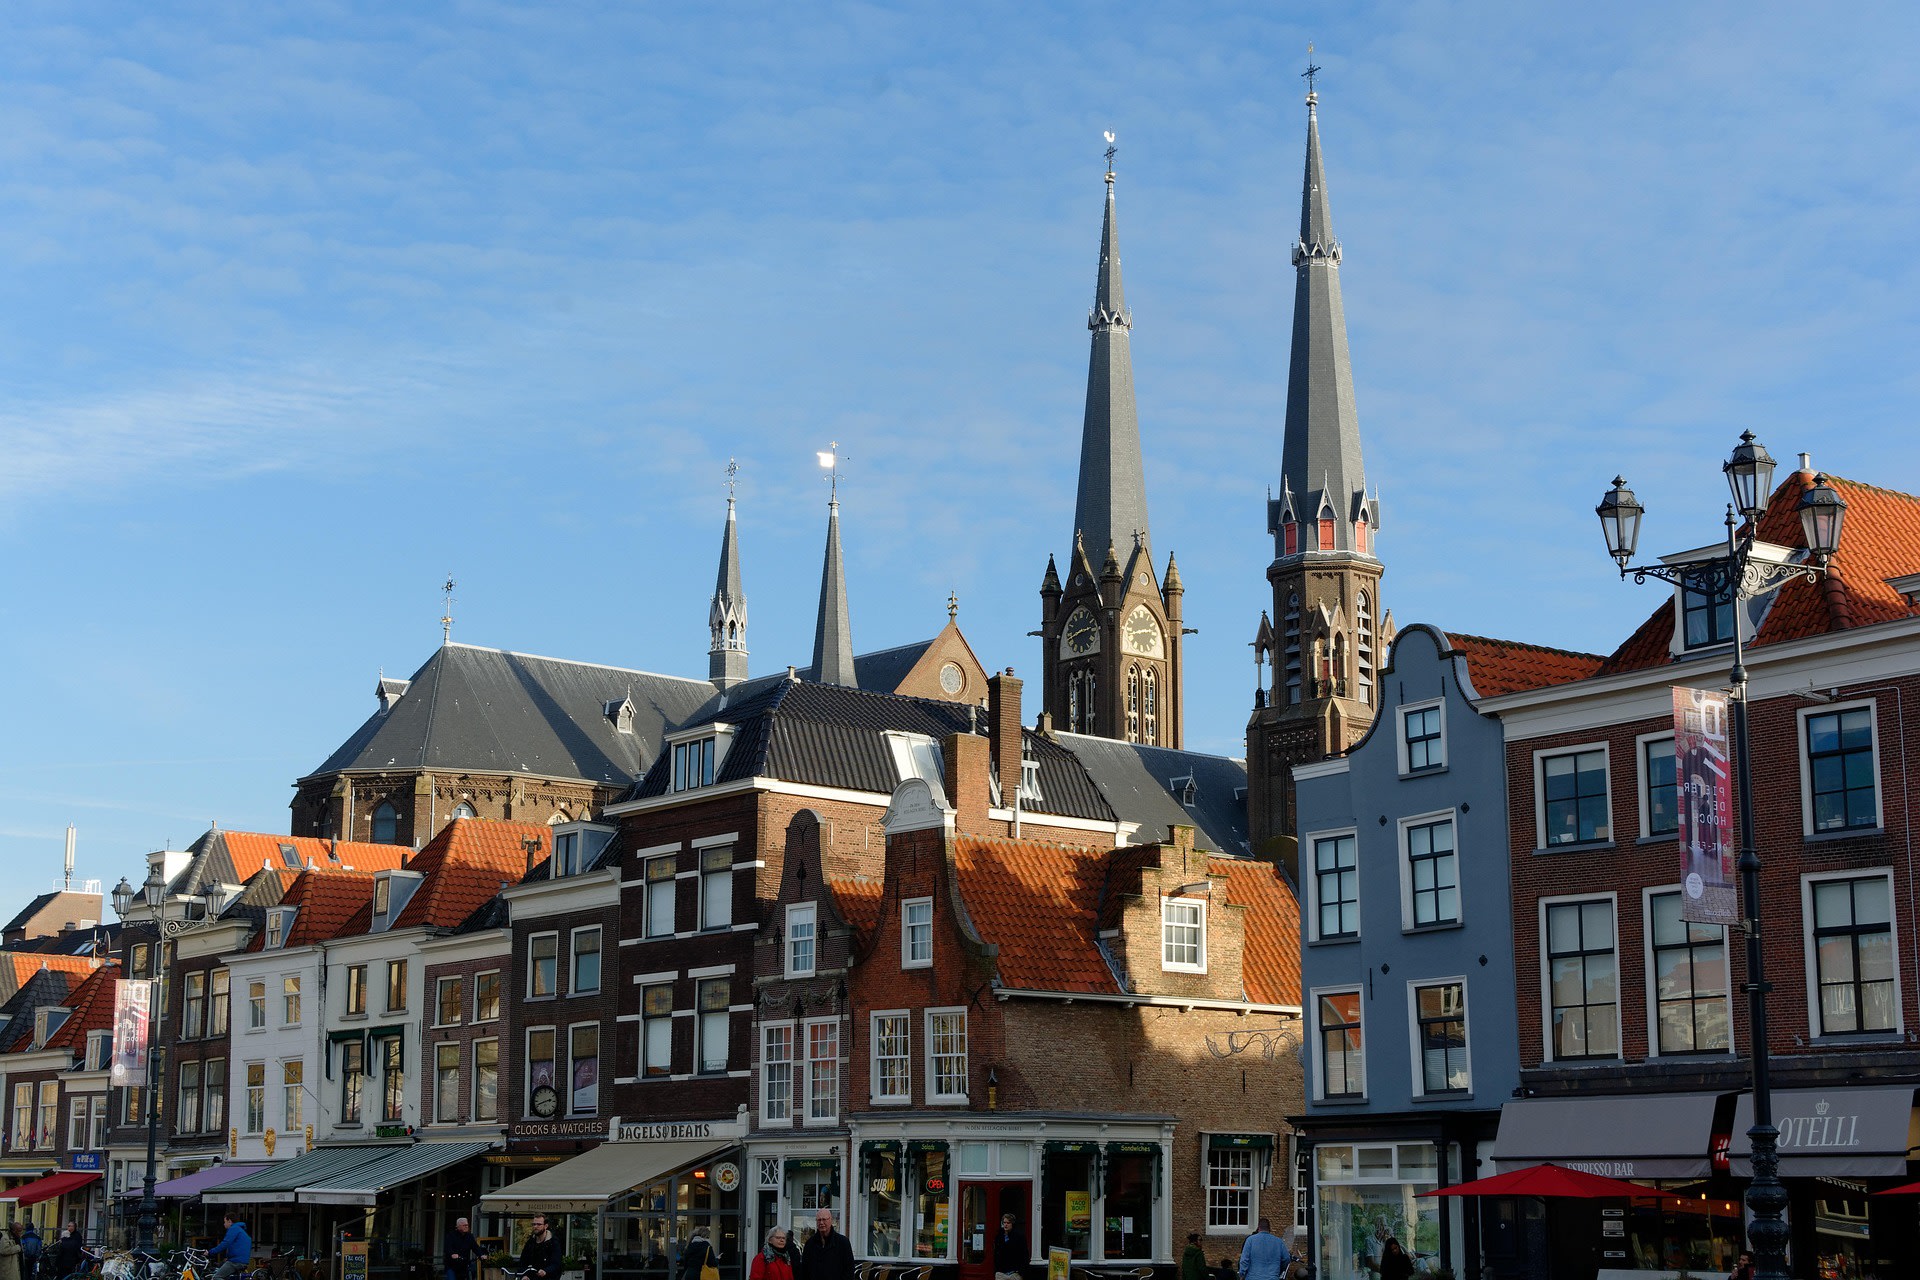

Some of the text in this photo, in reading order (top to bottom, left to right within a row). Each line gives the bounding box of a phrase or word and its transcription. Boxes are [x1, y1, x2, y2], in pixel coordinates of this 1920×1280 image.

[514, 1122, 603, 1135] CLOCKS & WATCHES
[618, 1126, 661, 1140] BAGELS
[1776, 1116, 1858, 1148] OTELLI
[1613, 1162, 1634, 1176] BAR
[927, 1179, 945, 1189] OPEN
